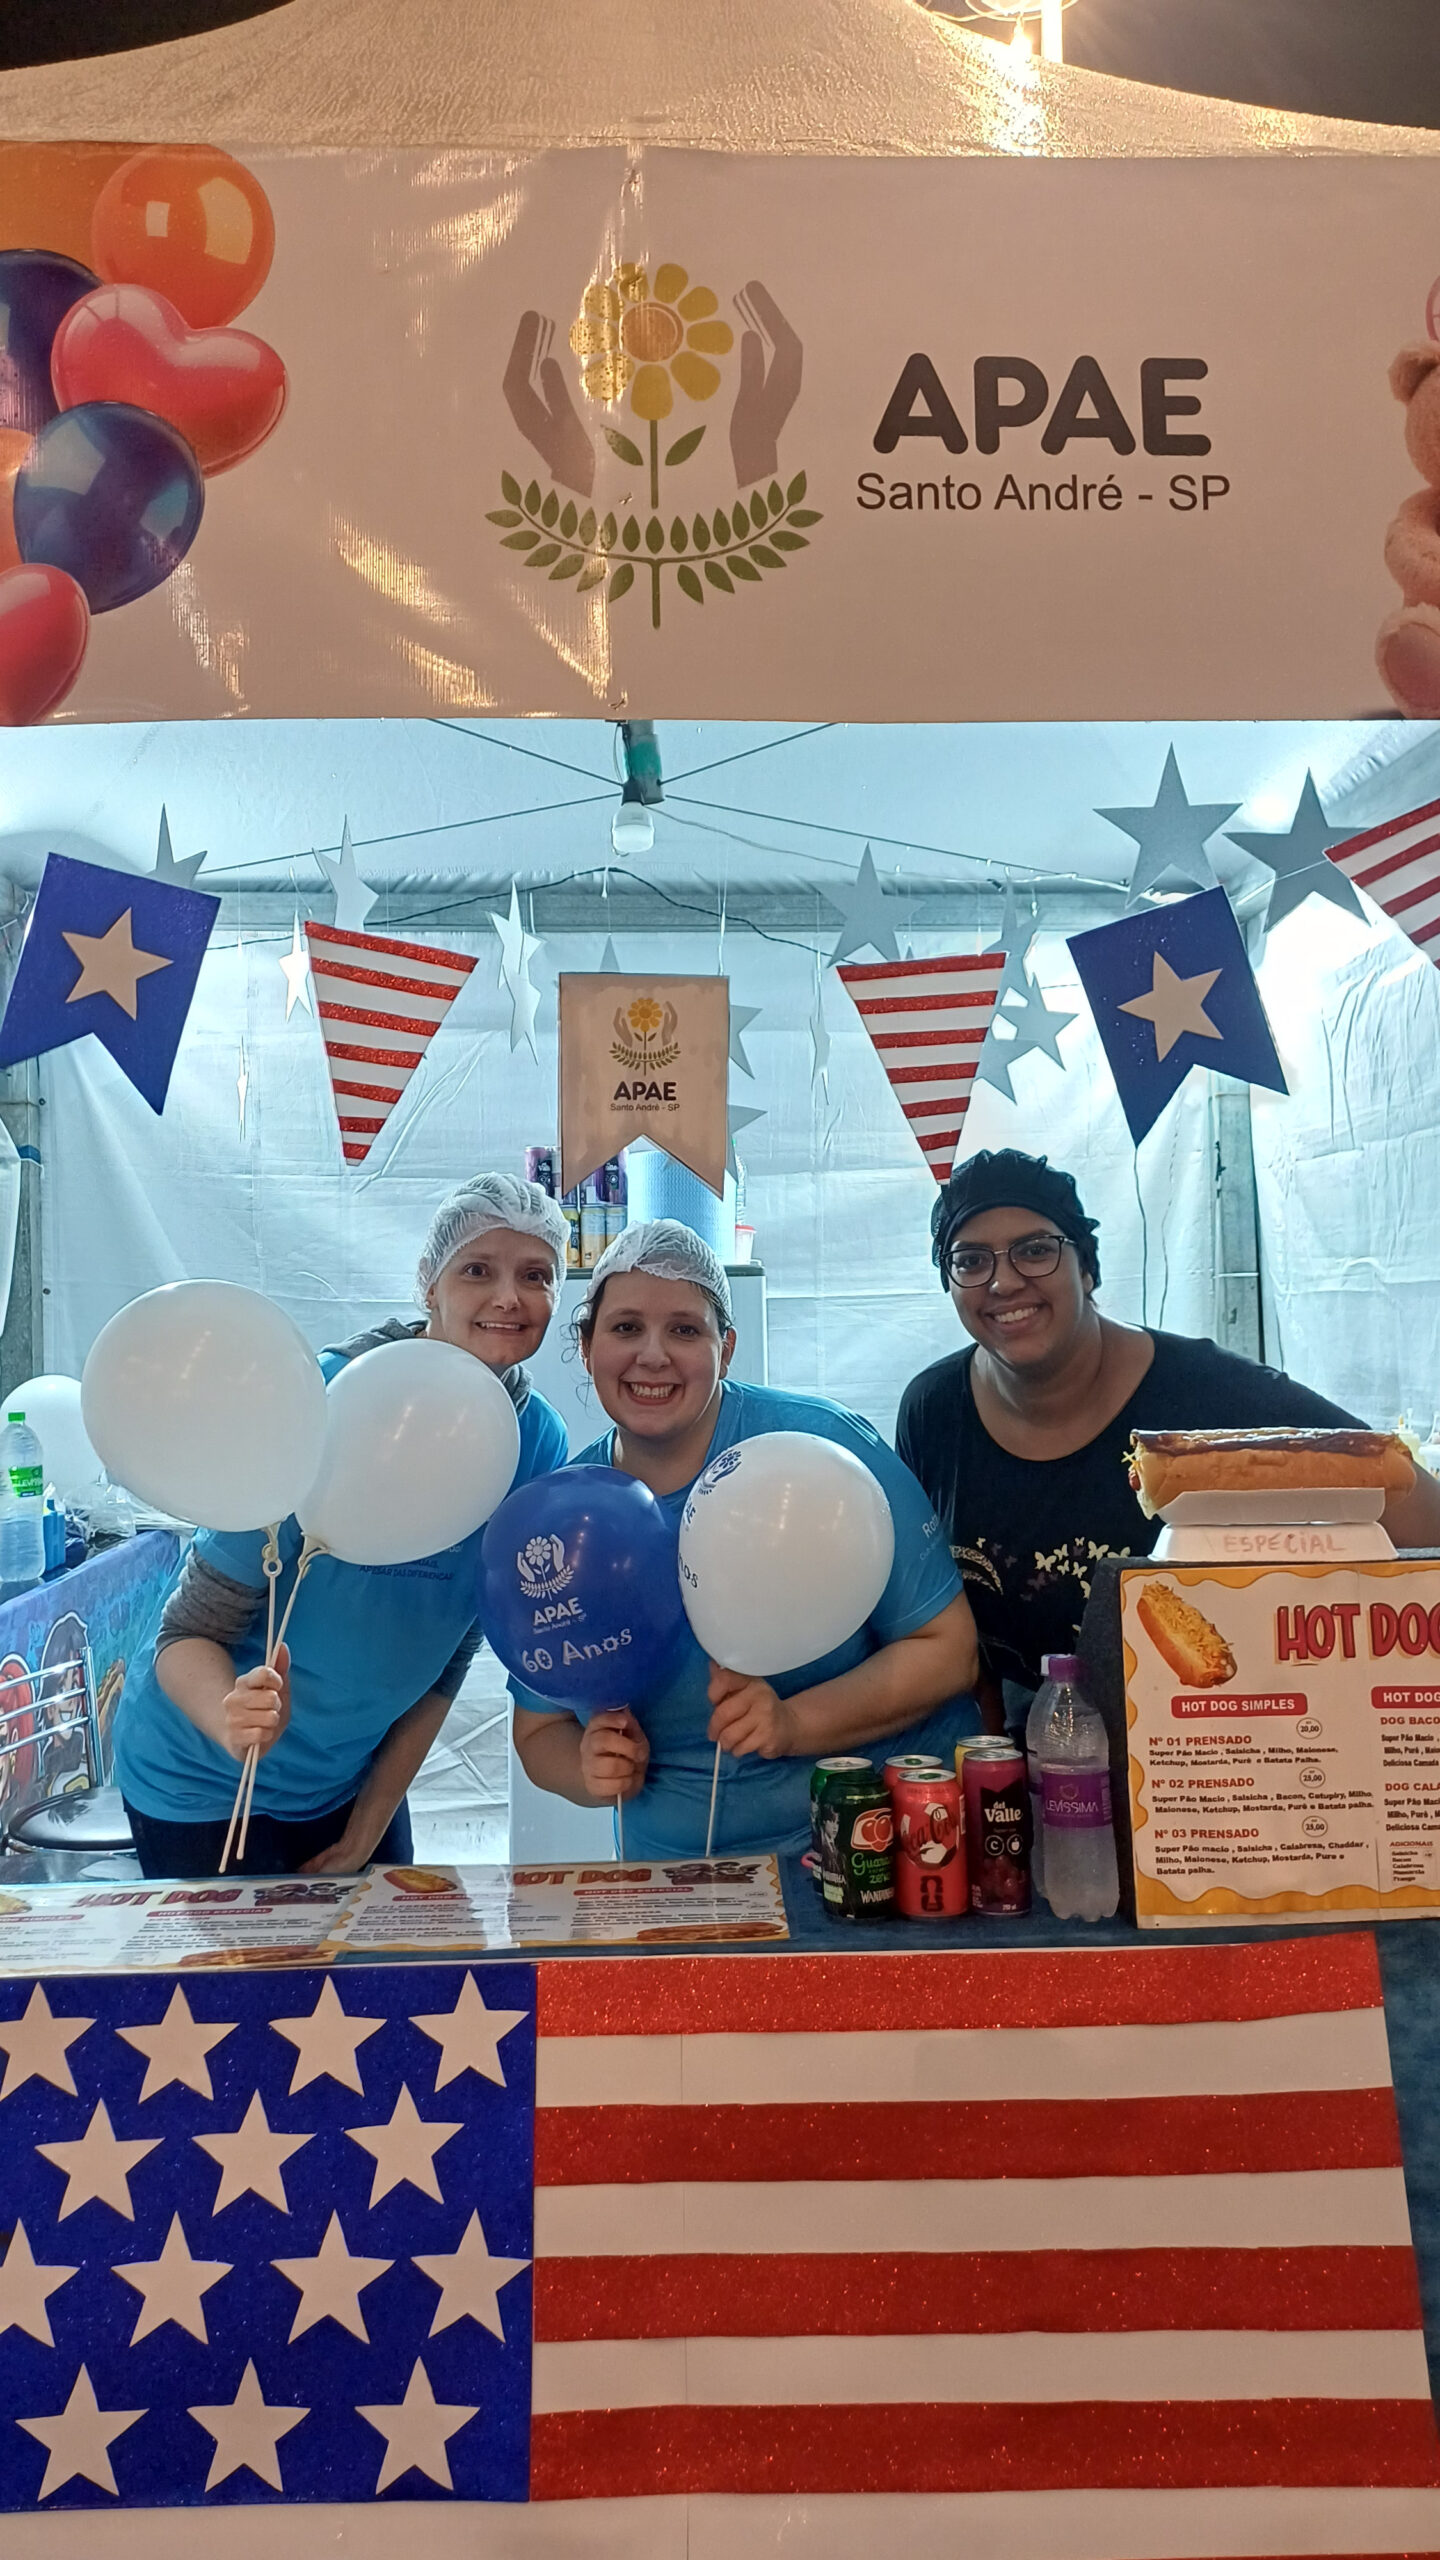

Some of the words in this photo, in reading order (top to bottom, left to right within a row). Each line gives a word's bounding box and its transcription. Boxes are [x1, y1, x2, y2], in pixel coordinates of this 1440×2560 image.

[873, 352, 1212, 456] APAE
[856, 473, 982, 511] Santo
[994, 473, 1124, 511] André
[1168, 473, 1231, 511] SP
[613, 1081, 677, 1100] APAE
[610, 1103, 634, 1111] Santo
[667, 1103, 680, 1111] SP
[680, 1552, 699, 1588] nos
[534, 1597, 584, 1627] APAE
[1275, 1603, 1361, 1662] HOT
[522, 1648, 553, 1672] 60
[562, 1628, 632, 1666] Anos
[1383, 1692, 1411, 1703] HOT
[1181, 1701, 1207, 1713] HOT
[1210, 1700, 1238, 1711] DOG
[1241, 1699, 1296, 1710] SIMPLES
[1380, 1716, 1406, 1725] DOG
[1167, 1737, 1181, 1747] 01
[1186, 1735, 1252, 1746] PRENSADO
[1169, 1779, 1185, 1789] 02
[1188, 1777, 1255, 1789] PRENSADO
[1385, 1783, 1409, 1791] DOG
[1199, 1795, 1225, 1803] Macio
[1232, 1793, 1268, 1801] Salsicha
[1276, 1793, 1306, 1801] Bacon,
[1308, 1792, 1347, 1800] Catupiry,
[1384, 1798, 1405, 1807] Super
[1155, 1806, 1200, 1814] Maionese,
[1349, 1801, 1374, 1810] palha.
[984, 1808, 1022, 1822] Valle
[1171, 1829, 1187, 1839] 03
[1190, 1828, 1259, 1839] PRENSADO
[1385, 1823, 1420, 1832] Deliciosa
[1155, 1846, 1180, 1854] Super
[1202, 1845, 1230, 1853] macio
[1237, 1844, 1273, 1852] Salsicha
[1280, 1843, 1326, 1851] Calabresa,
[1328, 1841, 1364, 1849] Cheddar
[1155, 1857, 1182, 1865] Milho,
[1184, 1856, 1230, 1864] Maionese,
[1232, 1855, 1270, 1864] Ketchup,
[1272, 1854, 1314, 1862] Mostarda,
[578, 1868, 652, 1884] DOG
[1156, 1867, 1186, 1875] Batata
[1188, 1866, 1215, 1875] palha.
[69, 1891, 163, 1908] HOT
[159, 1889, 244, 1905] DOG
